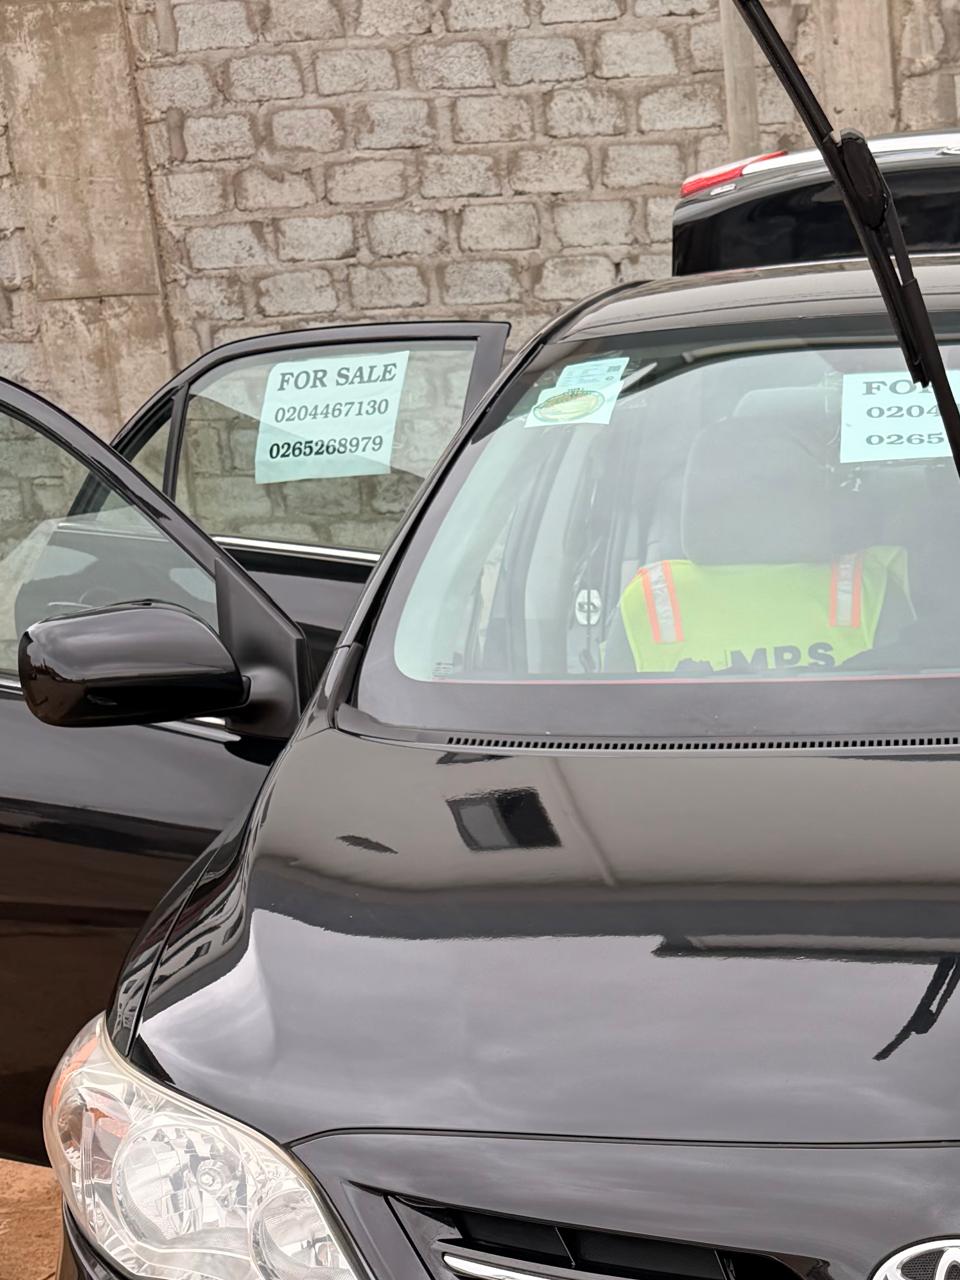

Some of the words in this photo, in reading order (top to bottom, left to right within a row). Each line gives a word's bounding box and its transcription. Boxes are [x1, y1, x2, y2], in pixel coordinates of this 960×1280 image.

[277, 369, 328, 391] FOR
[336, 363, 398, 386] SALE
[274, 399, 389, 423] 0204467130
[269, 435, 384, 459] 0265268979
